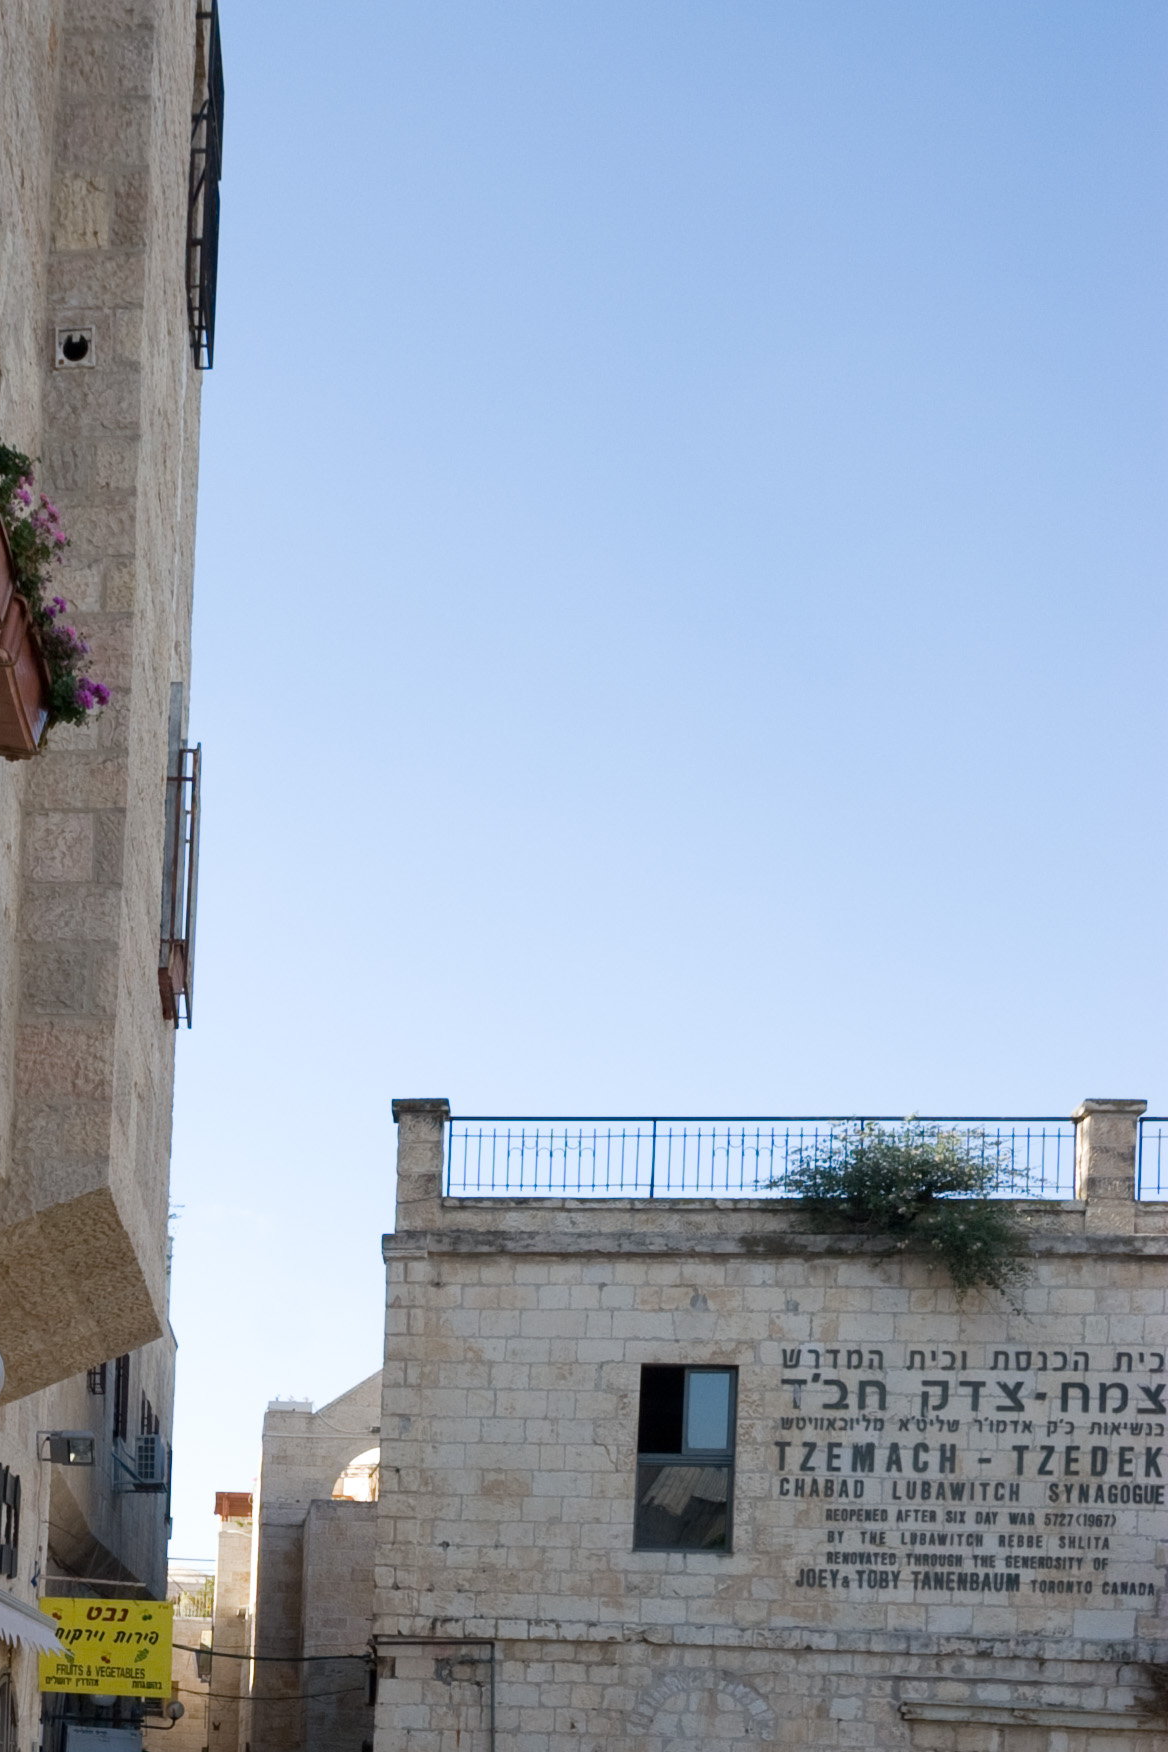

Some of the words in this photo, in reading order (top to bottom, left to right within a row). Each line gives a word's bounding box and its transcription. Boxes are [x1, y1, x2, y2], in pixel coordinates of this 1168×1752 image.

[782, 1348, 884, 1370] המדרש
[906, 1350, 968, 1370] ובית
[992, 1350, 1089, 1372] הכנסת
[1113, 1350, 1165, 1372] בית
[780, 1415, 884, 1432] מליובאוויטש
[1089, 1421, 1165, 1437] בנשיאות
[775, 1442, 956, 1473] TZEMACH
[1012, 1445, 1163, 1478] TZEDEK
[779, 1478, 865, 1499] CHABAD
[893, 1482, 1020, 1501] LUBAWITCH
[1049, 1483, 1165, 1505] SYNAGOGUE
[826, 1509, 887, 1522] REOPENED
[897, 1511, 936, 1523] AFTER
[946, 1511, 966, 1524] SIX
[975, 1512, 999, 1525] DAY
[1009, 1512, 1035, 1525] WAR
[828, 1531, 844, 1544] BY
[861, 1532, 886, 1545] THE
[901, 1533, 983, 1546] LUBAWITCH
[999, 1535, 1043, 1548] REBBE
[1059, 1535, 1110, 1550] SHLITA
[827, 1552, 896, 1565] RENOVATED
[906, 1554, 962, 1567] THROUGH
[974, 1554, 996, 1568] THE
[1005, 1556, 1083, 1570] GENEROSITY
[1093, 1557, 1108, 1571] OF
[795, 1570, 839, 1588] JOEY
[856, 1570, 901, 1589] TOBY
[911, 1572, 1020, 1591] TANENBAUM
[1031, 1580, 1092, 1594] TORONTO
[1102, 1582, 1155, 1596] CANADA
[87, 1607, 129, 1622] נבט
[114, 1630, 159, 1645] פירות
[56, 1664, 83, 1676] FRUITS
[87, 1665, 91, 1676] &
[96, 1666, 145, 1679] VEGETABLES
